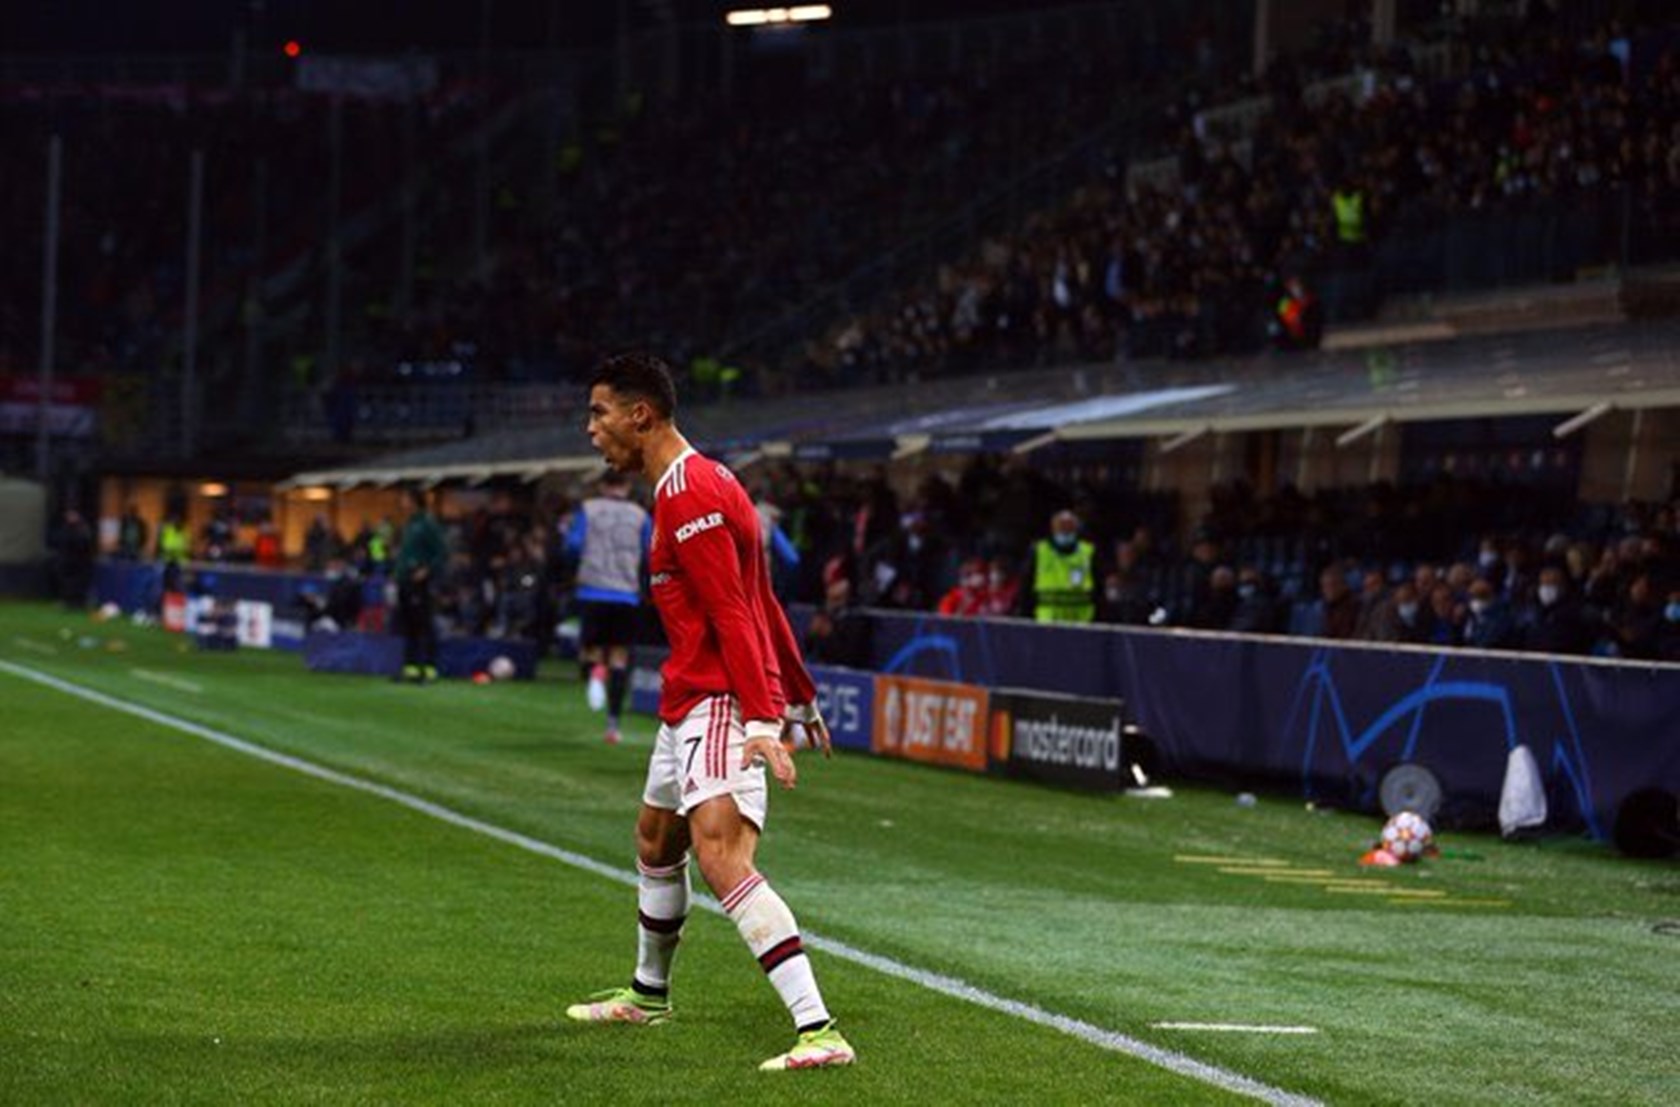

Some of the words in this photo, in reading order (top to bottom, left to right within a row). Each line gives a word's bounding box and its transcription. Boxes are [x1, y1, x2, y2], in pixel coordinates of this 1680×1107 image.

[675, 512, 724, 543] KOHLER
[903, 690, 943, 749] JUST
[944, 696, 977, 753] EAT
[1015, 713, 1119, 771] mastercard
[684, 734, 703, 774] 7
